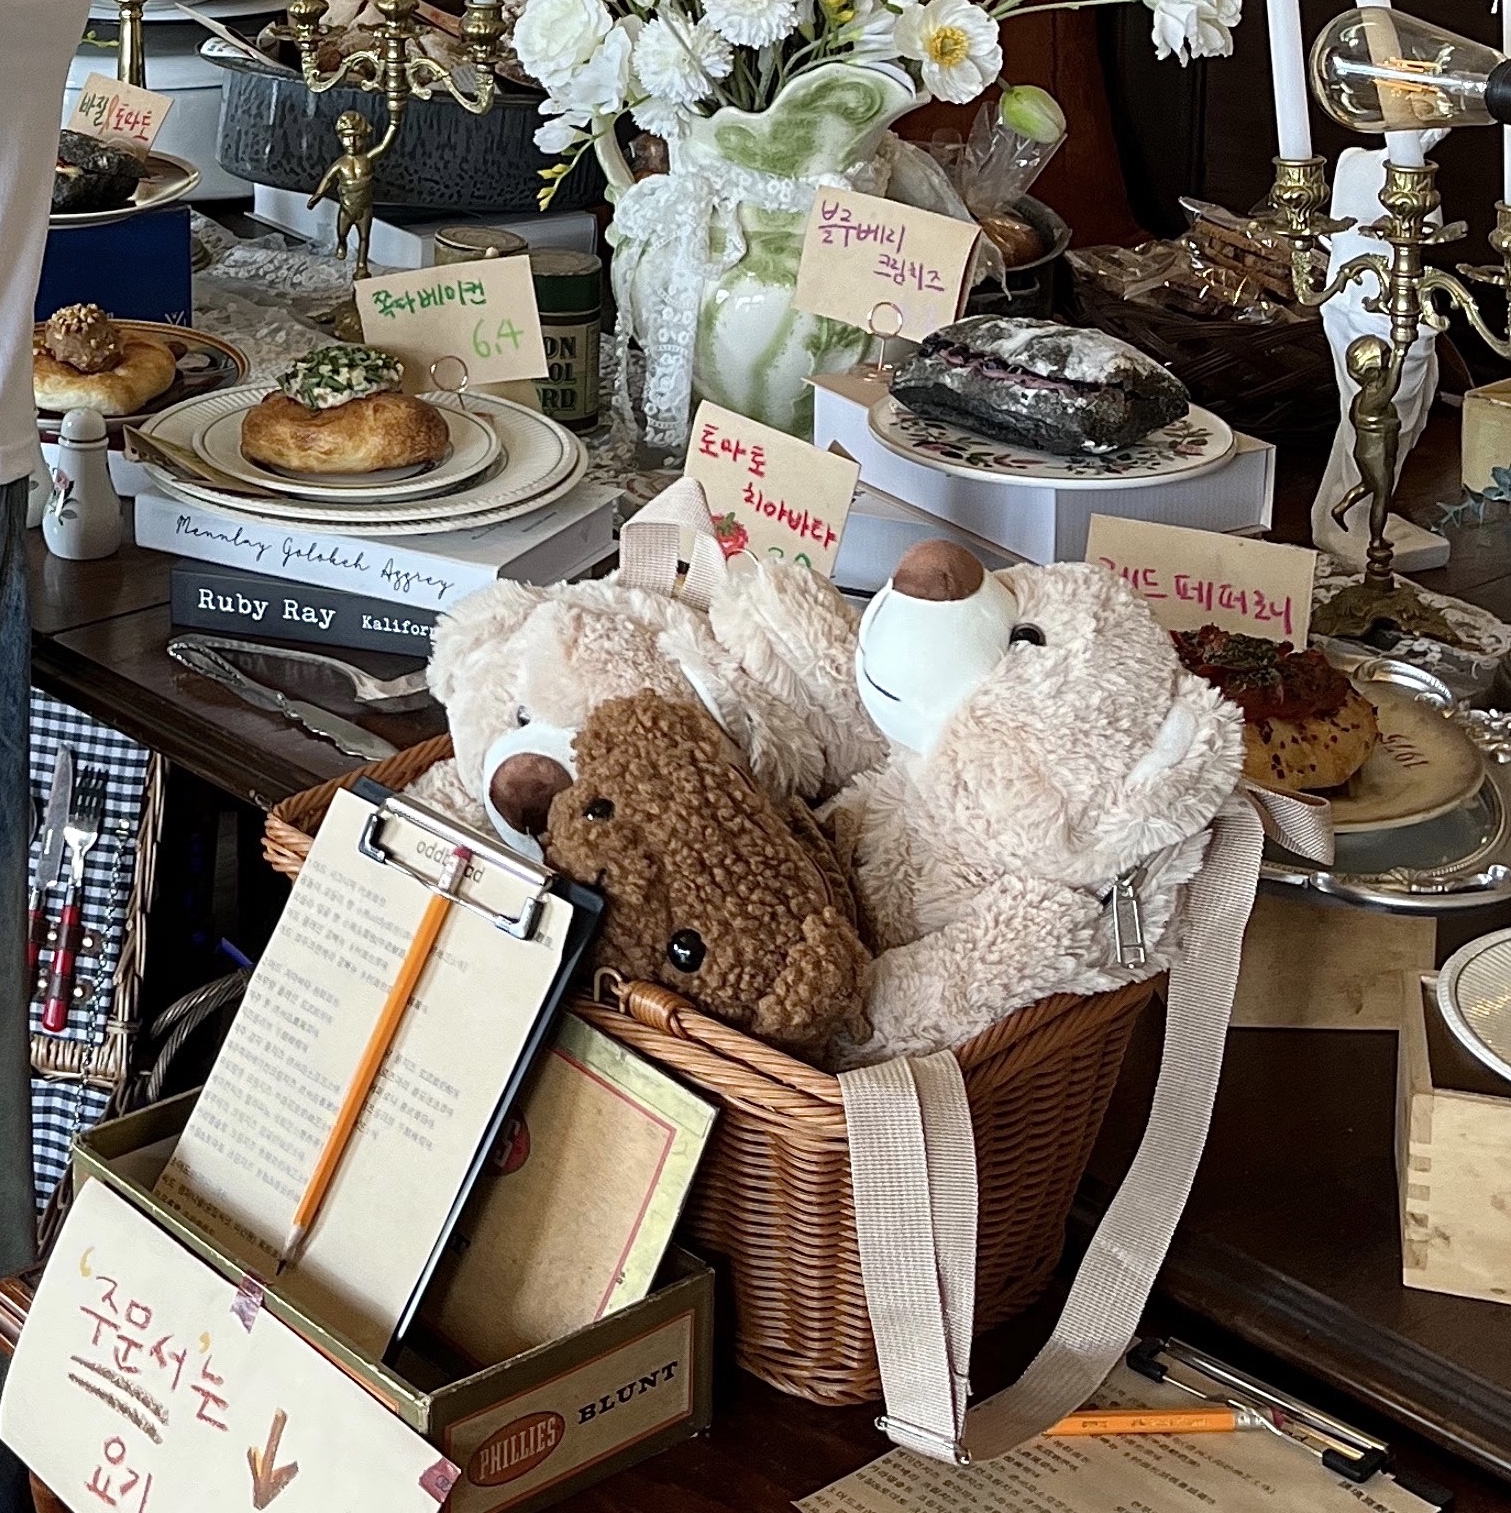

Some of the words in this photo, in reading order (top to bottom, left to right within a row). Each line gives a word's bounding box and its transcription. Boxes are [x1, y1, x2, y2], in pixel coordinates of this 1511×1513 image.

[817, 199, 906, 254] 블루베리
[873, 253, 945, 292] 크림치즈
[698, 423, 767, 479] 토마토
[742, 481, 838, 550] 치아바타
[197, 587, 269, 622] Ruby
[282, 598, 337, 630] Ray
[1174, 574, 1294, 635] 페퍼로니
[478, 1415, 558, 1481] PHILLIES
[576, 1359, 680, 1426] BLUNT
